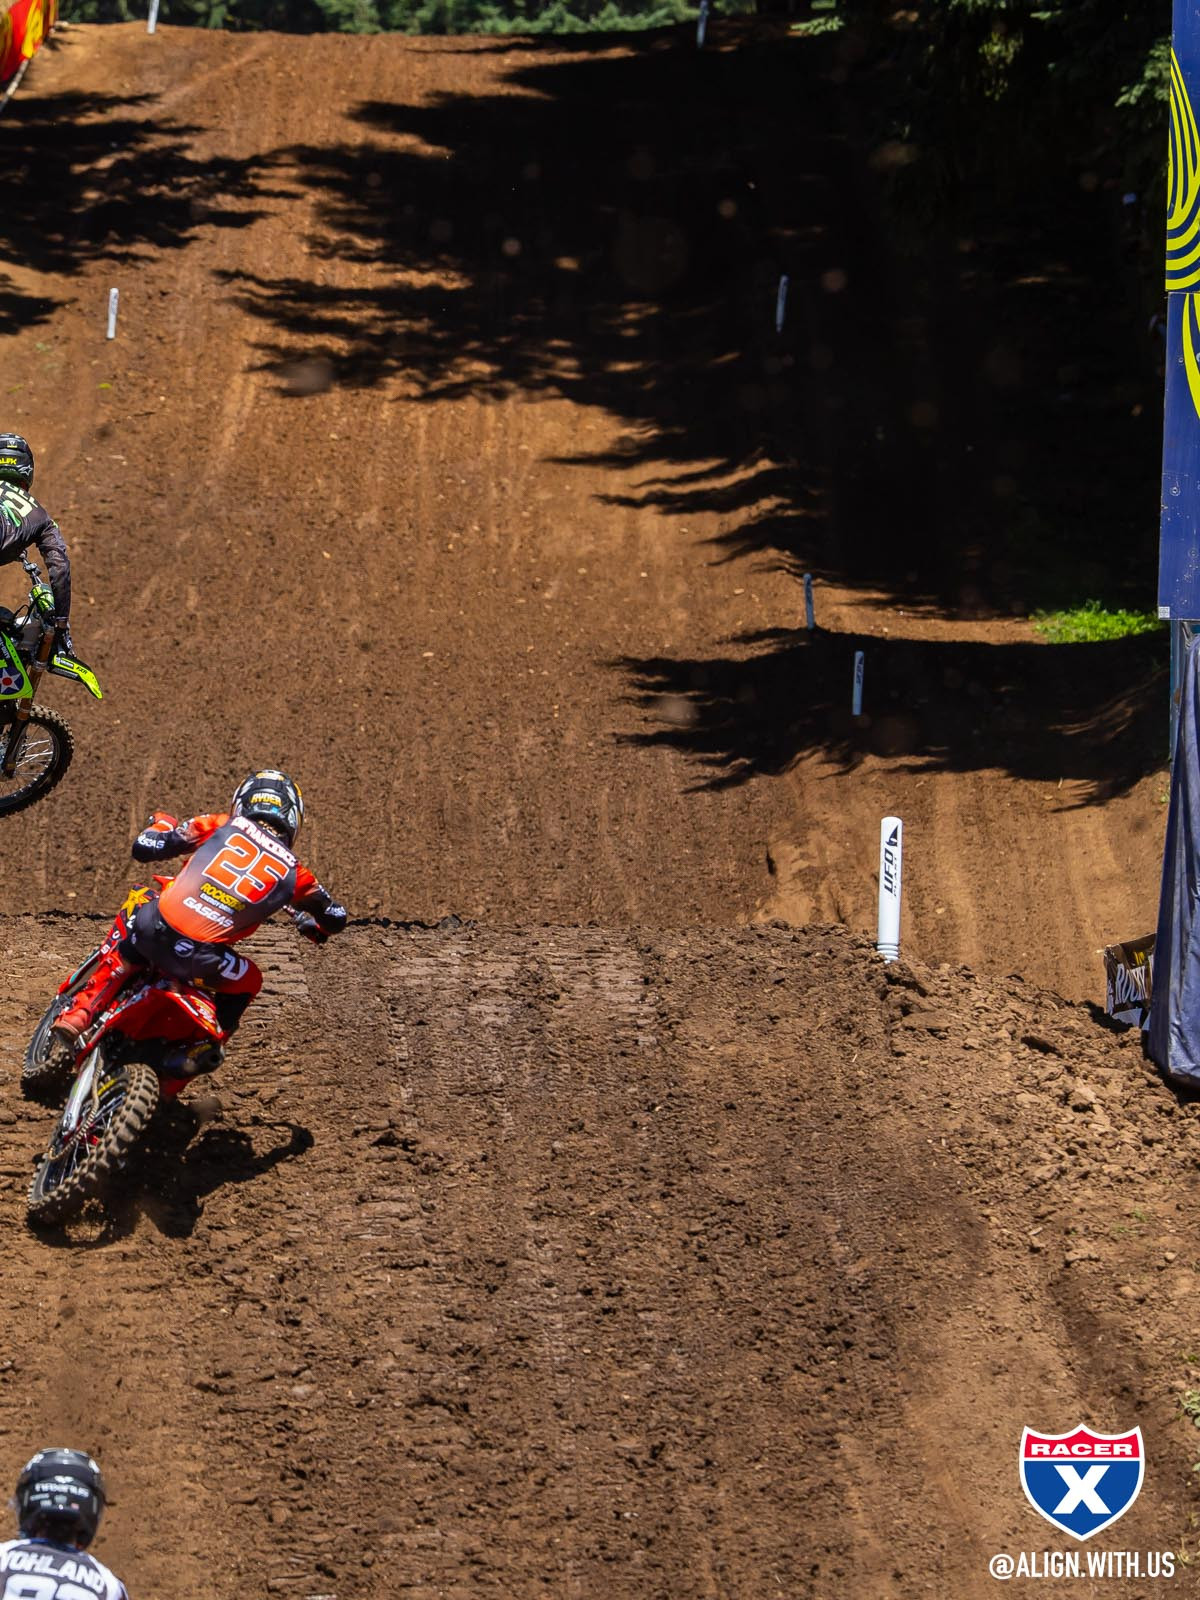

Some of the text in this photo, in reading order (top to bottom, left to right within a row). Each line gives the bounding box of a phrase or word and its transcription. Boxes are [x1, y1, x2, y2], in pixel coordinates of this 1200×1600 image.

[250, 792, 282, 807] RYDER
[201, 832, 290, 903] 25
[883, 848, 894, 894] UFO
[182, 896, 234, 927] GASGAS
